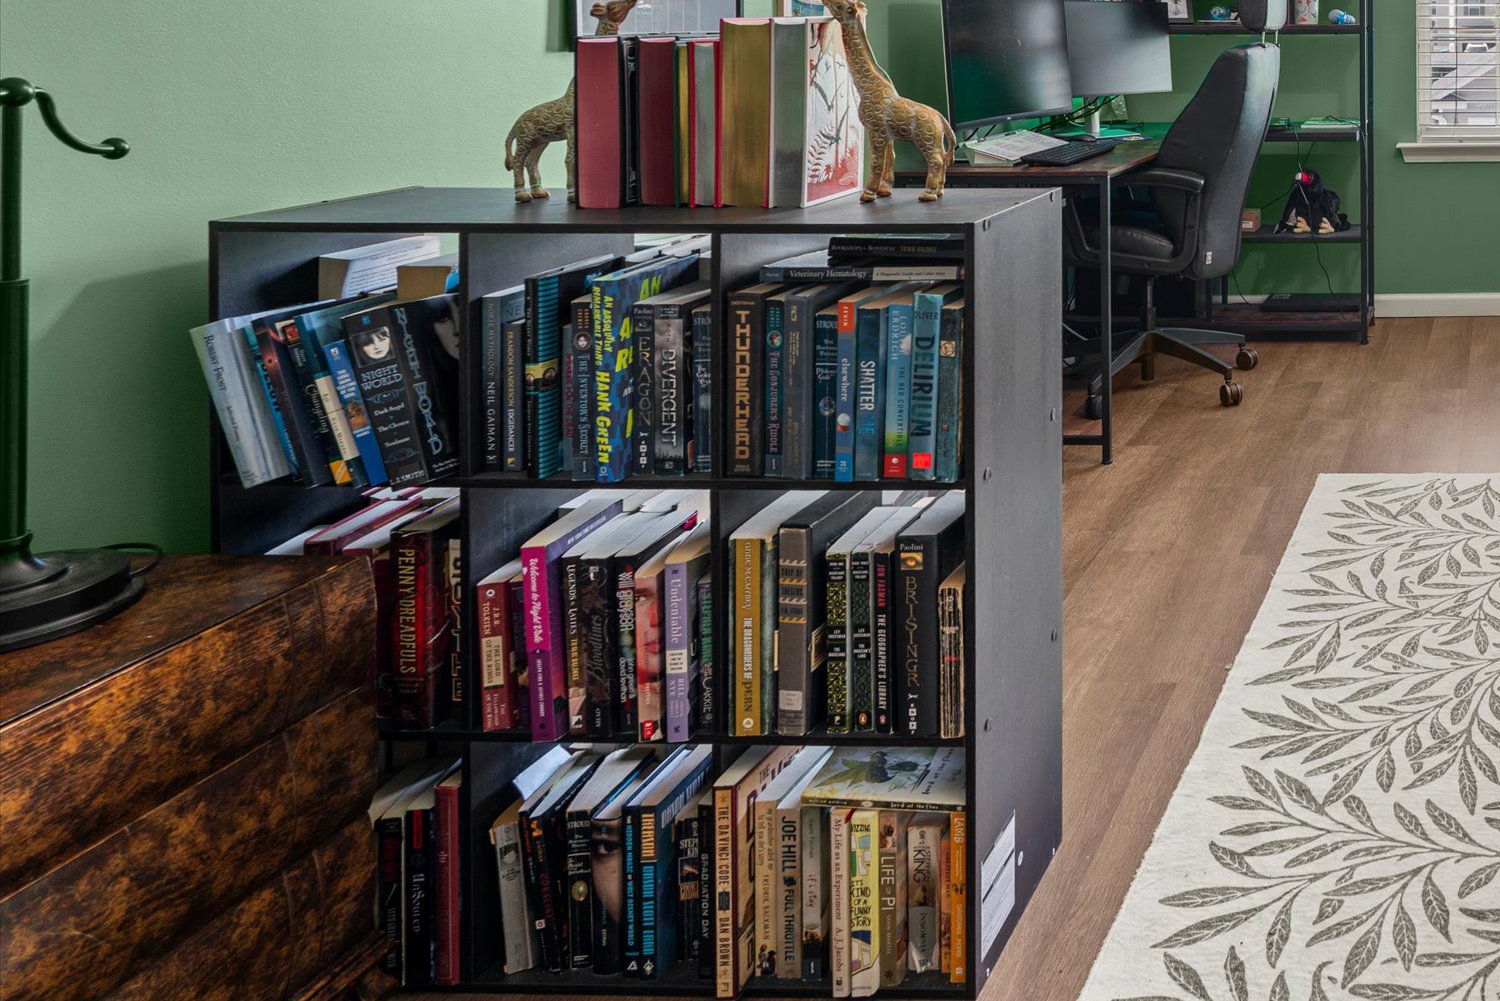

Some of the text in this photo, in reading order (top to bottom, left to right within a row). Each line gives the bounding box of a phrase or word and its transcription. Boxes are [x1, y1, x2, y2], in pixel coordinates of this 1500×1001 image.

[790, 269, 867, 280] Veterinary Hematology
[604, 296, 614, 307] AN
[914, 311, 939, 320] OLIVER
[891, 310, 900, 361] ERDRICH
[204, 335, 227, 391] ROBERT FROST
[361, 364, 398, 381] NIGHT
[361, 374, 403, 390] WORLD
[395, 308, 443, 455] NIGHT WORLD
[487, 303, 496, 450] NORSE MYTHOLOGY NEIL GAIMAN
[638, 336, 652, 427] ERAGON
[840, 358, 849, 403] elsewhere
[911, 333, 935, 437] DELIRIUM
[578, 353, 591, 454] THE INVENTOR'S SECRET
[662, 349, 676, 446] DIVERGENT
[735, 311, 750, 460] THUNDERHEAD
[768, 351, 781, 452] THE CONJURER'S RIDDLE
[858, 360, 876, 436] SHATTER ME
[305, 384, 329, 434] Changeling
[596, 371, 612, 463] HANK GREEN
[398, 550, 416, 594] PENNY
[567, 564, 576, 600] LEGENDS
[876, 563, 886, 607] JON FASMAN
[483, 602, 491, 635] TOLKIEN
[530, 558, 543, 644] Welcome to Night Vale
[568, 608, 578, 635] LATTES
[616, 573, 628, 631] will grayson
[622, 572, 634, 631] will grayson
[670, 578, 681, 644] Undeniable
[744, 617, 752, 627] THE
[400, 600, 416, 673] DREADFULS
[486, 640, 492, 648] OF
[905, 576, 919, 687] BRISINGR
[877, 614, 887, 710] THE GEOGRAPHER'S LIBRARY
[668, 680, 676, 697] NYE
[625, 825, 633, 850] HIDDEN
[680, 838, 699, 849] STEP
[781, 816, 797, 872] JOE HILL
[833, 819, 842, 832] My
[834, 834, 842, 850] Life
[954, 817, 964, 844] LAMB
[718, 806, 730, 967] THE DA VINCI CODE DAN BROWN
[880, 856, 895, 885] LIFE
[914, 850, 926, 883] KING
[806, 890, 817, 908] stay
[833, 874, 843, 920] Experiment
[881, 897, 895, 910] PI
[701, 919, 709, 938] DAY
[784, 889, 795, 961] FULL THROTTLE
[836, 928, 842, 937] A.
[851, 916, 871, 927] STORY
